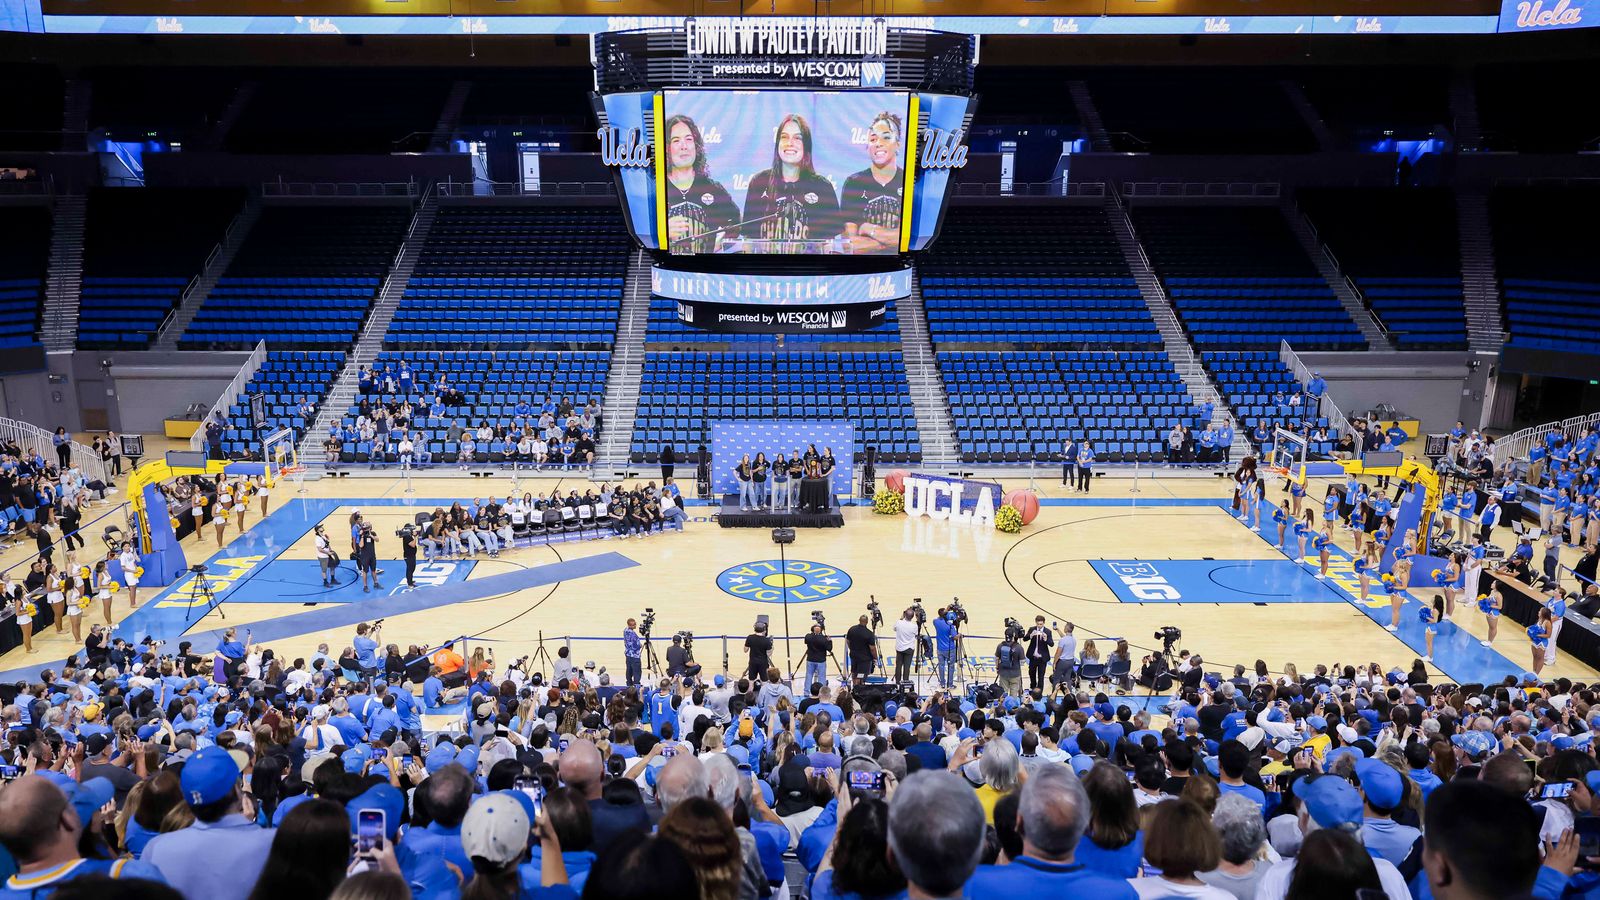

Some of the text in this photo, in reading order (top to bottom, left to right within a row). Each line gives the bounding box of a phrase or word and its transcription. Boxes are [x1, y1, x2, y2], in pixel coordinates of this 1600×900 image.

[1516, 0, 1583, 28] Ucla
[686, 20, 887, 55] EDWIN W PAULEY PAVILION
[713, 61, 860, 77] presented by WESCOM
[824, 77, 860, 87] Financial
[597, 127, 651, 168] Ucla
[920, 128, 969, 169] Ucla
[718, 312, 829, 325] presented by WESCOM
[903, 477, 997, 527] UCLA
[729, 582, 842, 601] UCLA
